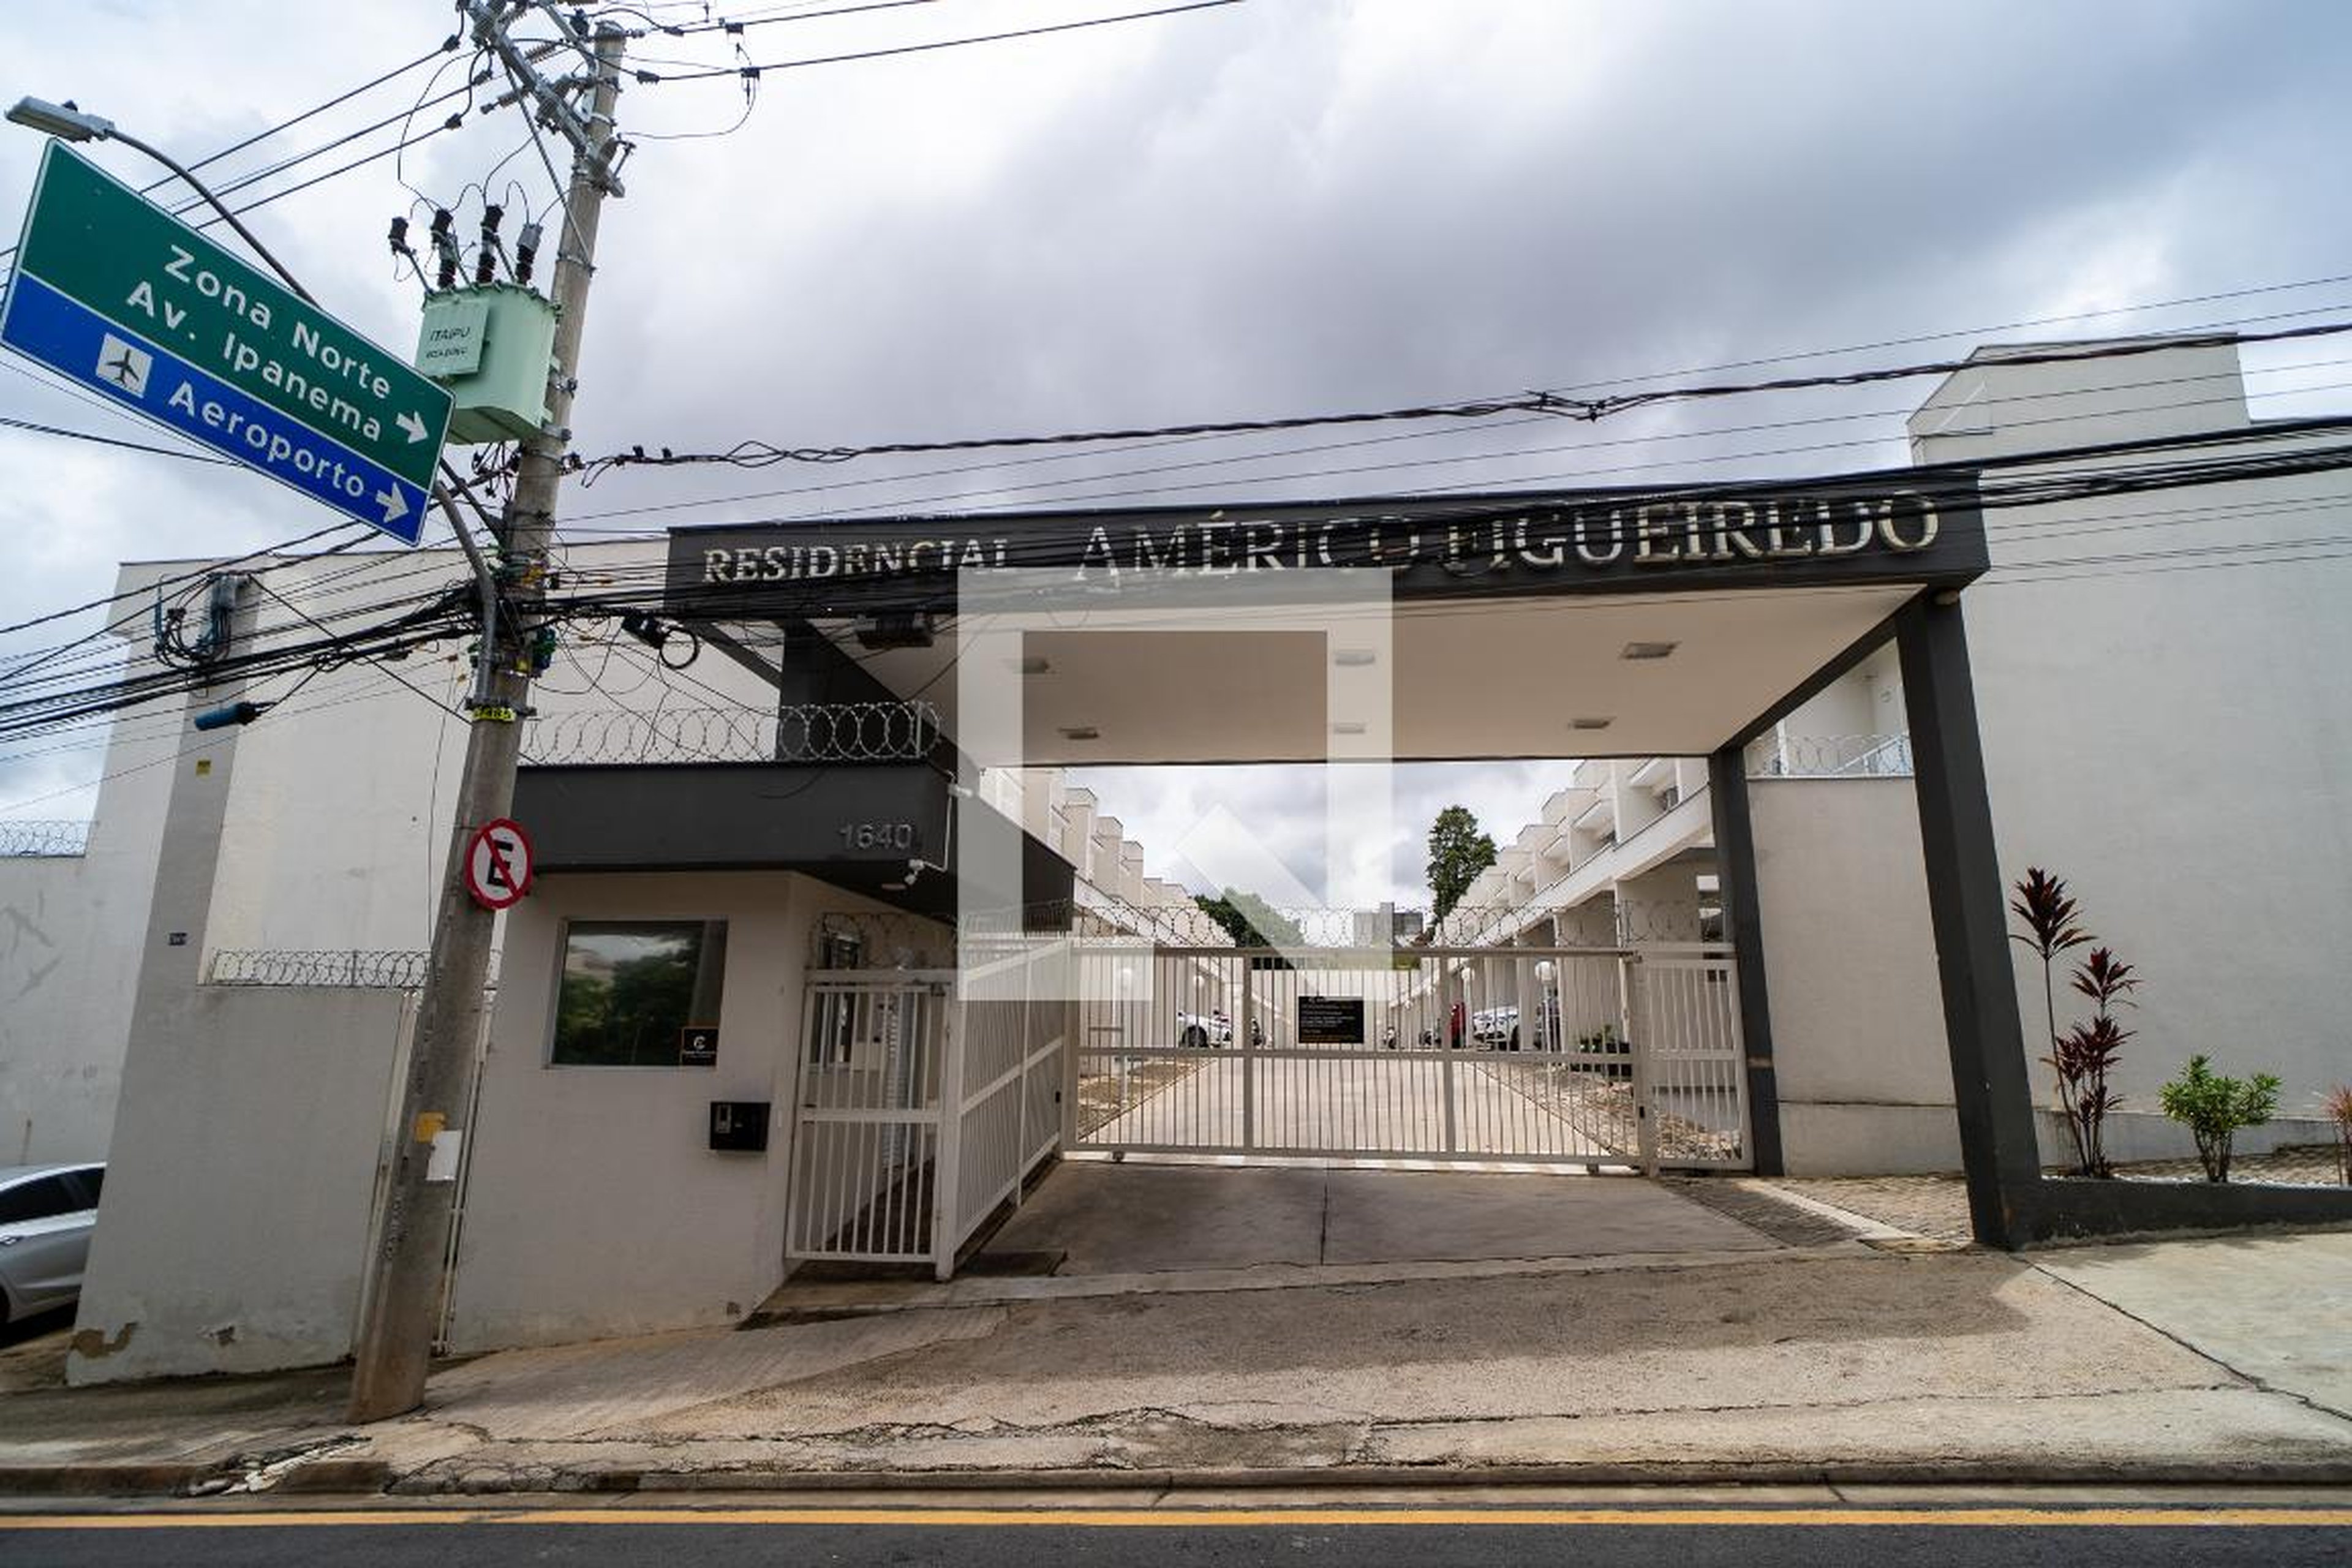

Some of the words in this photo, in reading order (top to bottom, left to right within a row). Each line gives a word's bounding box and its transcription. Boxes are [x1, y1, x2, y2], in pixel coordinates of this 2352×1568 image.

[126, 281, 196, 341] Av.
[222, 332, 383, 442] Ipanema
[164, 245, 271, 330] Zona
[292, 321, 391, 399] Norte
[430, 326, 470, 341] ITAIPU
[168, 382, 365, 498] Aeroporto
[839, 824, 911, 850] 1640
